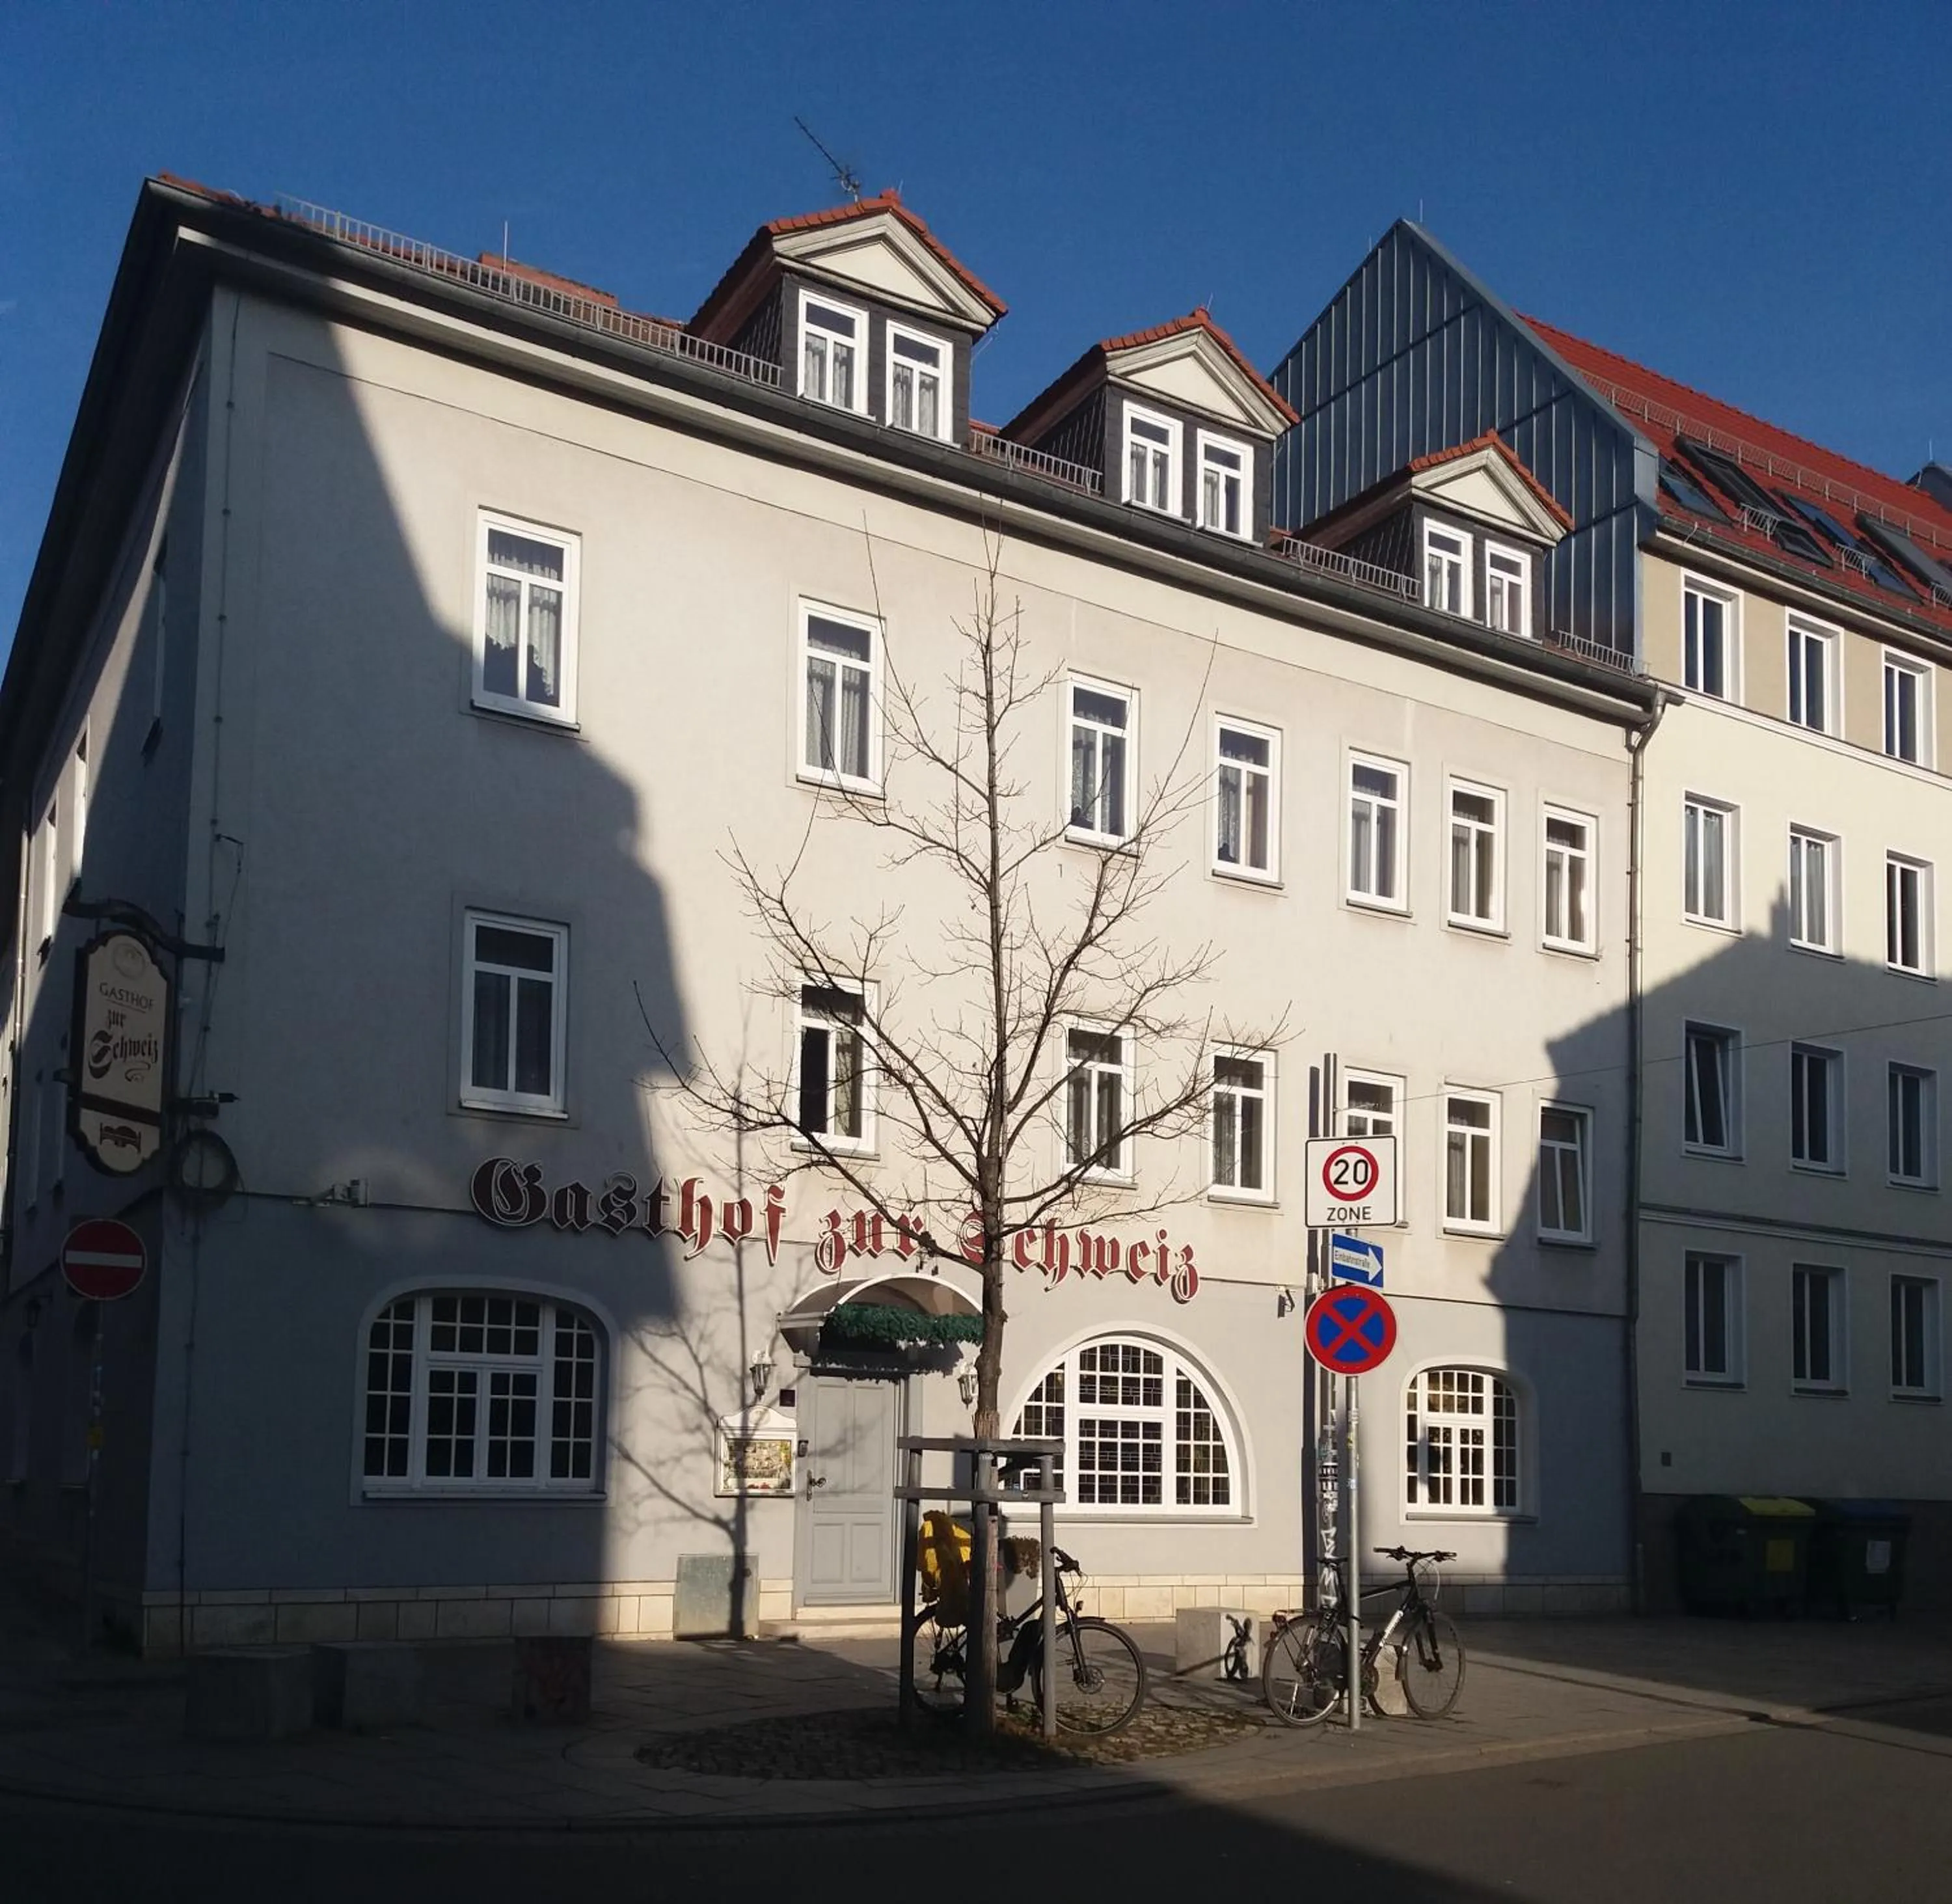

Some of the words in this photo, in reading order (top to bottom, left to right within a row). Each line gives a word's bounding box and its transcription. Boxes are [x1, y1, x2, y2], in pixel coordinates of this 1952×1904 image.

[99, 983, 155, 1010] GASTHOF
[107, 1009, 127, 1028] zur
[88, 1029, 159, 1080] Schweiz
[1333, 1159, 1368, 1185] 20
[470, 1156, 787, 1266] Gasthof
[815, 1208, 926, 1276] zur
[1327, 1206, 1372, 1221] ZONE
